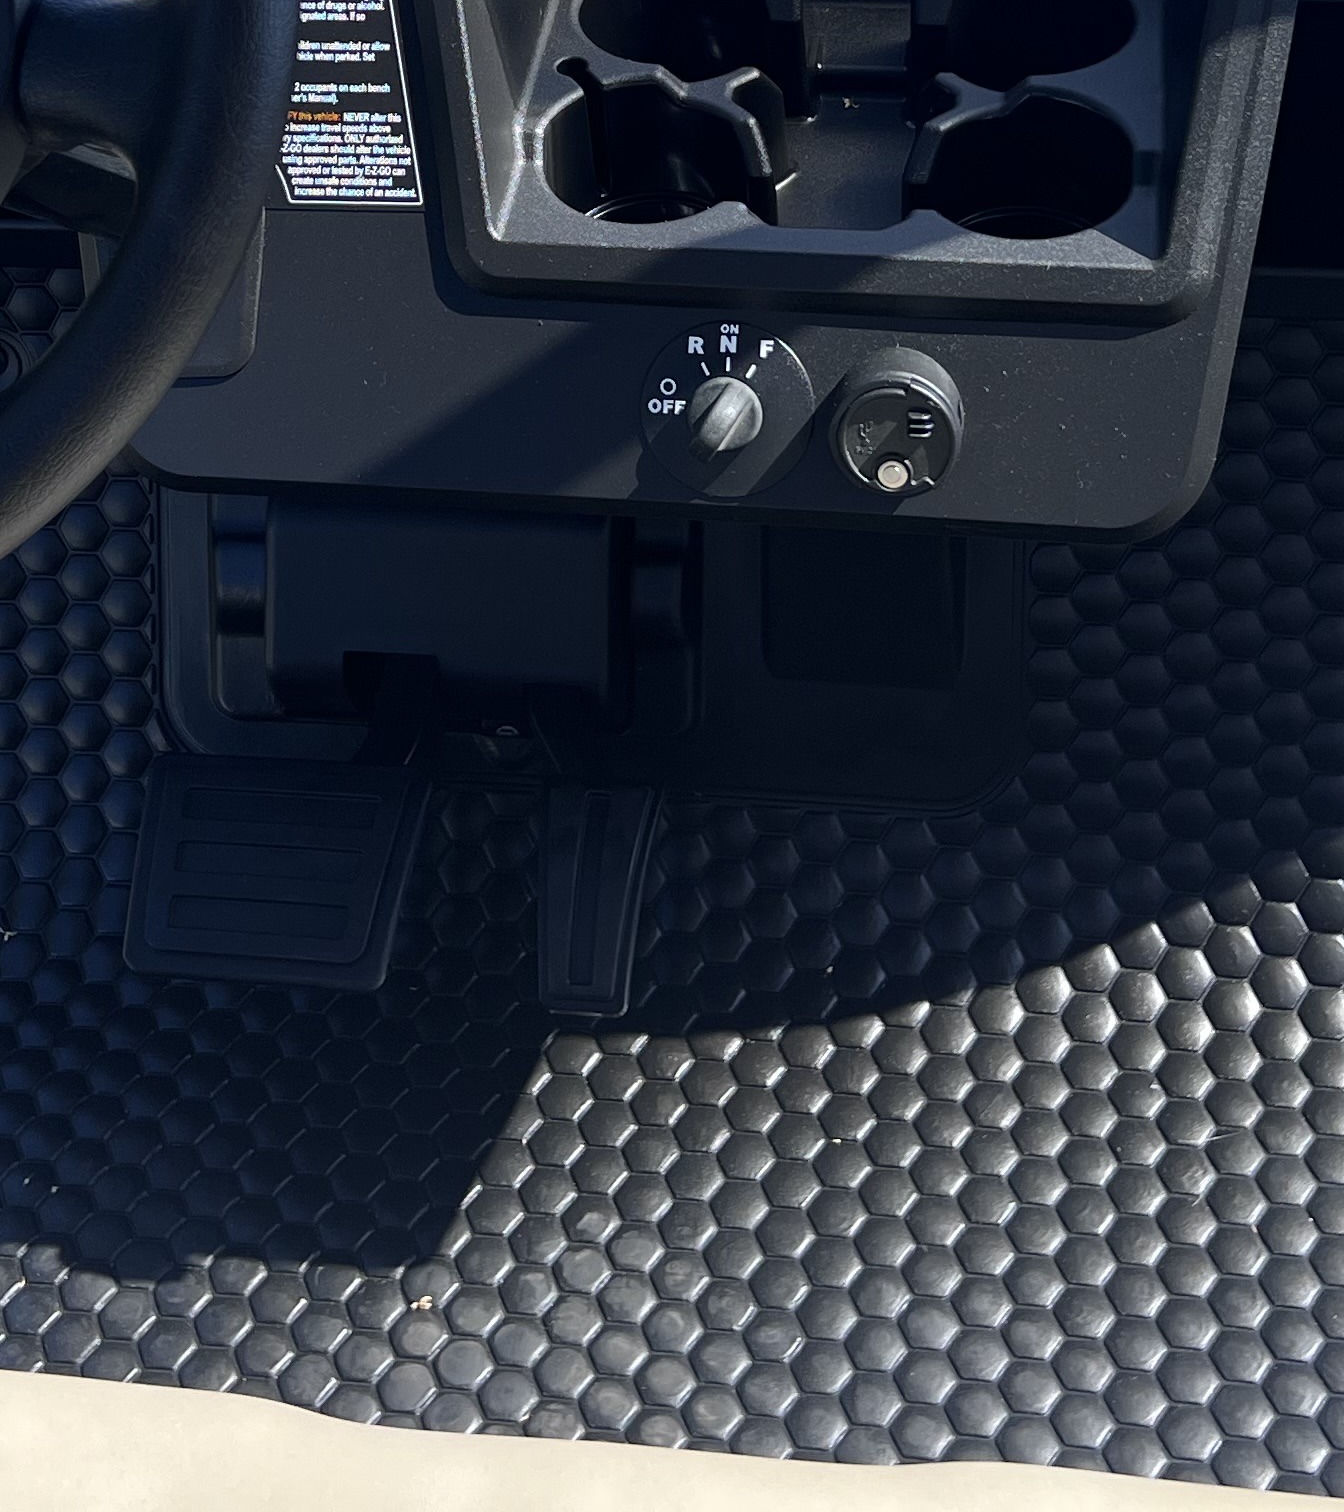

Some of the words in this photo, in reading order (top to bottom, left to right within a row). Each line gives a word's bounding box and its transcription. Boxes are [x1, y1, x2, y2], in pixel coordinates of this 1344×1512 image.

[316, 0, 325, 9] of
[325, 0, 347, 12] drugs
[347, 2, 356, 10] or
[356, 13, 366, 21] so
[321, 40, 361, 50] unattended
[361, 42, 371, 51] or
[371, 41, 391, 51] allow
[314, 51, 334, 61] when
[334, 51, 361, 63] parked.
[362, 51, 376, 61] Set
[294, 81, 300, 91] 2
[300, 82, 338, 93] occupants
[338, 84, 349, 92] on
[349, 82, 367, 93] each
[367, 82, 391, 93] bench
[342, 112, 370, 121] NEVER
[387, 113, 402, 123] this
[320, 123, 342, 132] travel
[342, 123, 368, 134] speeds
[368, 123, 391, 132] above
[293, 133, 343, 144] specifications.
[344, 134, 366, 143] ONLY
[303, 144, 329, 153] dealers
[329, 144, 355, 153] should
[372, 145, 384, 154] the
[385, 145, 412, 154] vehicle
[303, 155, 337, 165] approved
[359, 155, 398, 165] Alterations
[398, 155, 412, 165] not
[287, 166, 322, 175] approved
[322, 167, 331, 175] or
[331, 166, 353, 175] tested
[354, 166, 365, 176] by
[365, 166, 392, 175] E-Z-GO
[392, 167, 406, 176] can
[291, 176, 314, 185] create
[314, 176, 340, 185] unsafe
[340, 176, 377, 186] conditions
[378, 177, 393, 186] and
[294, 186, 325, 196] increase
[325, 187, 338, 196] the
[338, 187, 365, 196] chance
[365, 187, 373, 196] of
[373, 189, 384, 197] an
[384, 187, 417, 198] accident.
[720, 324, 740, 335] ON
[687, 336, 705, 355] R
[719, 336, 737, 354] N
[759, 340, 775, 358] F
[647, 399, 687, 416] OFF
